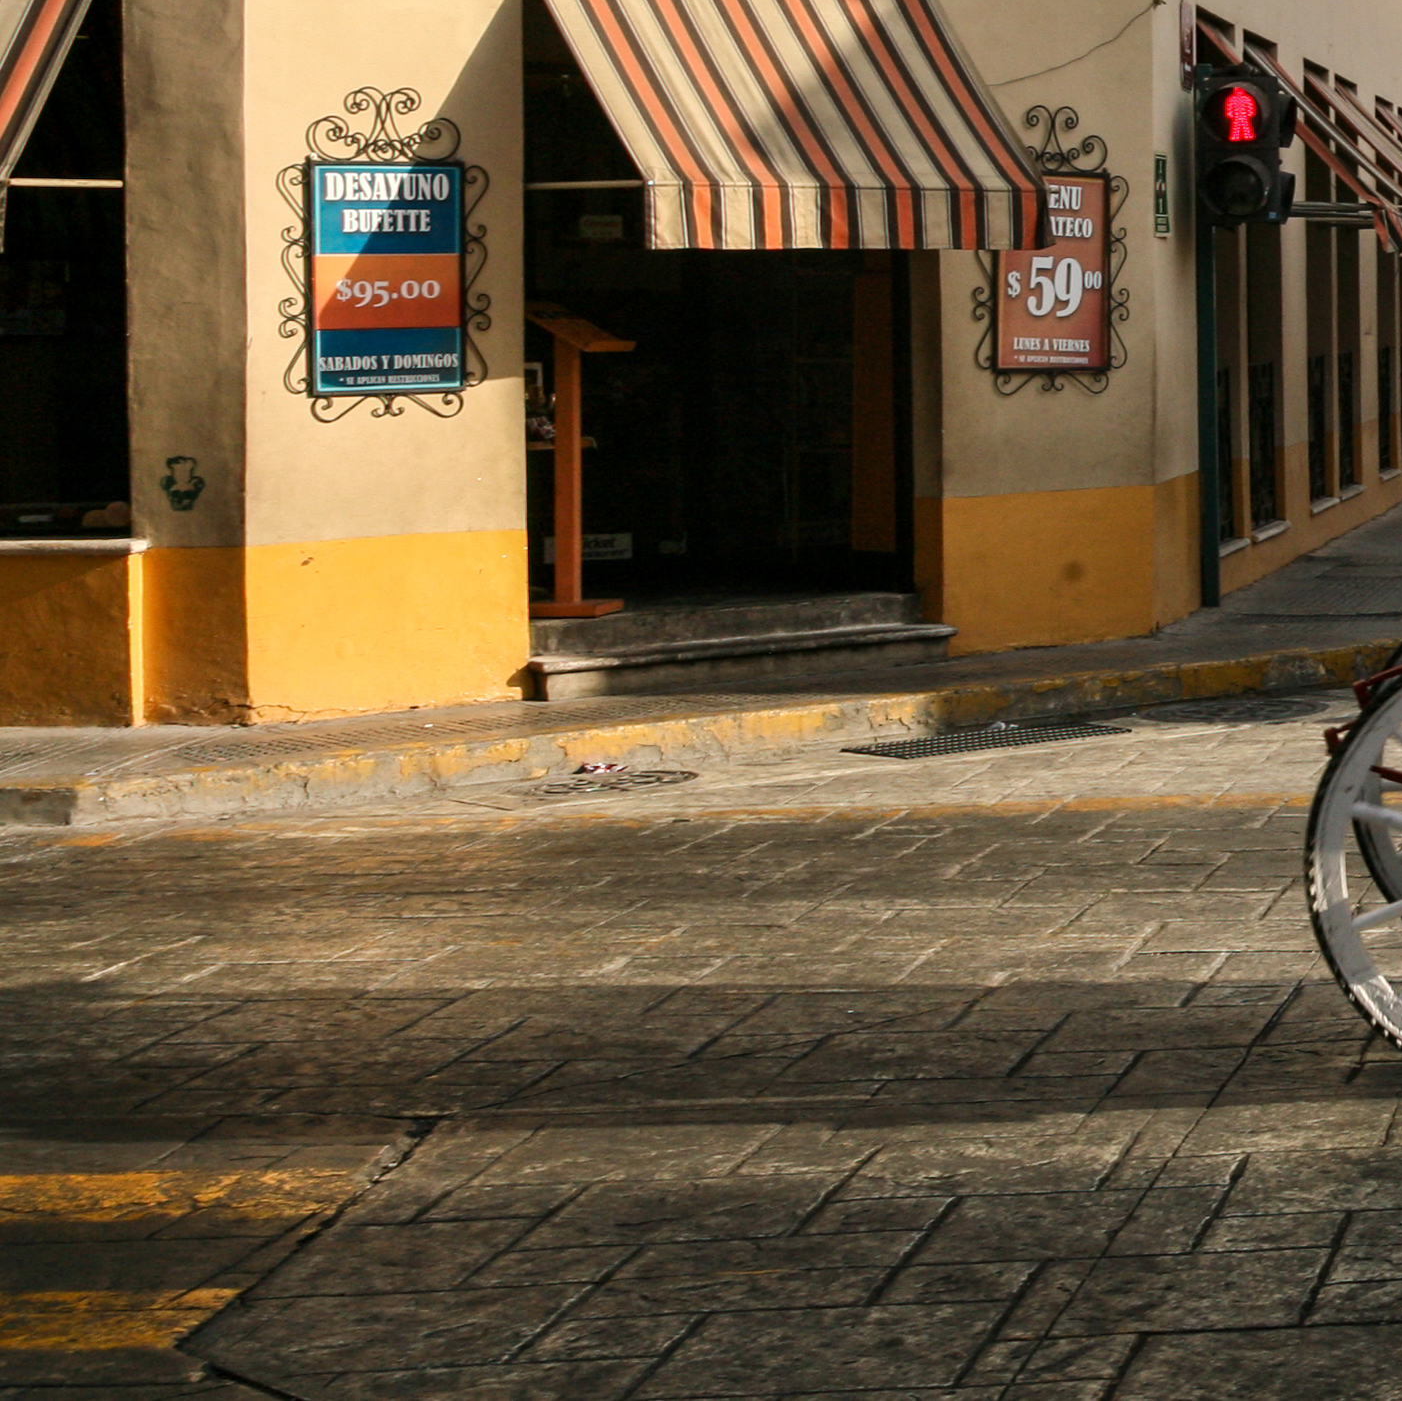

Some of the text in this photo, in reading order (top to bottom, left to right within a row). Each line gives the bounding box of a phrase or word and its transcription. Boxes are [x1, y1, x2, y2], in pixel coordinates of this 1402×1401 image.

[324, 172, 450, 202] DESAYUNO
[1048, 184, 1083, 211] ENU
[342, 209, 431, 233] BUFETTE
[336, 278, 441, 308] $95.00
[1007, 271, 1021, 297] $
[1013, 337, 1090, 352] LUNES A VIERNES
[318, 353, 459, 372] SABADOS Y DOMINGOS
